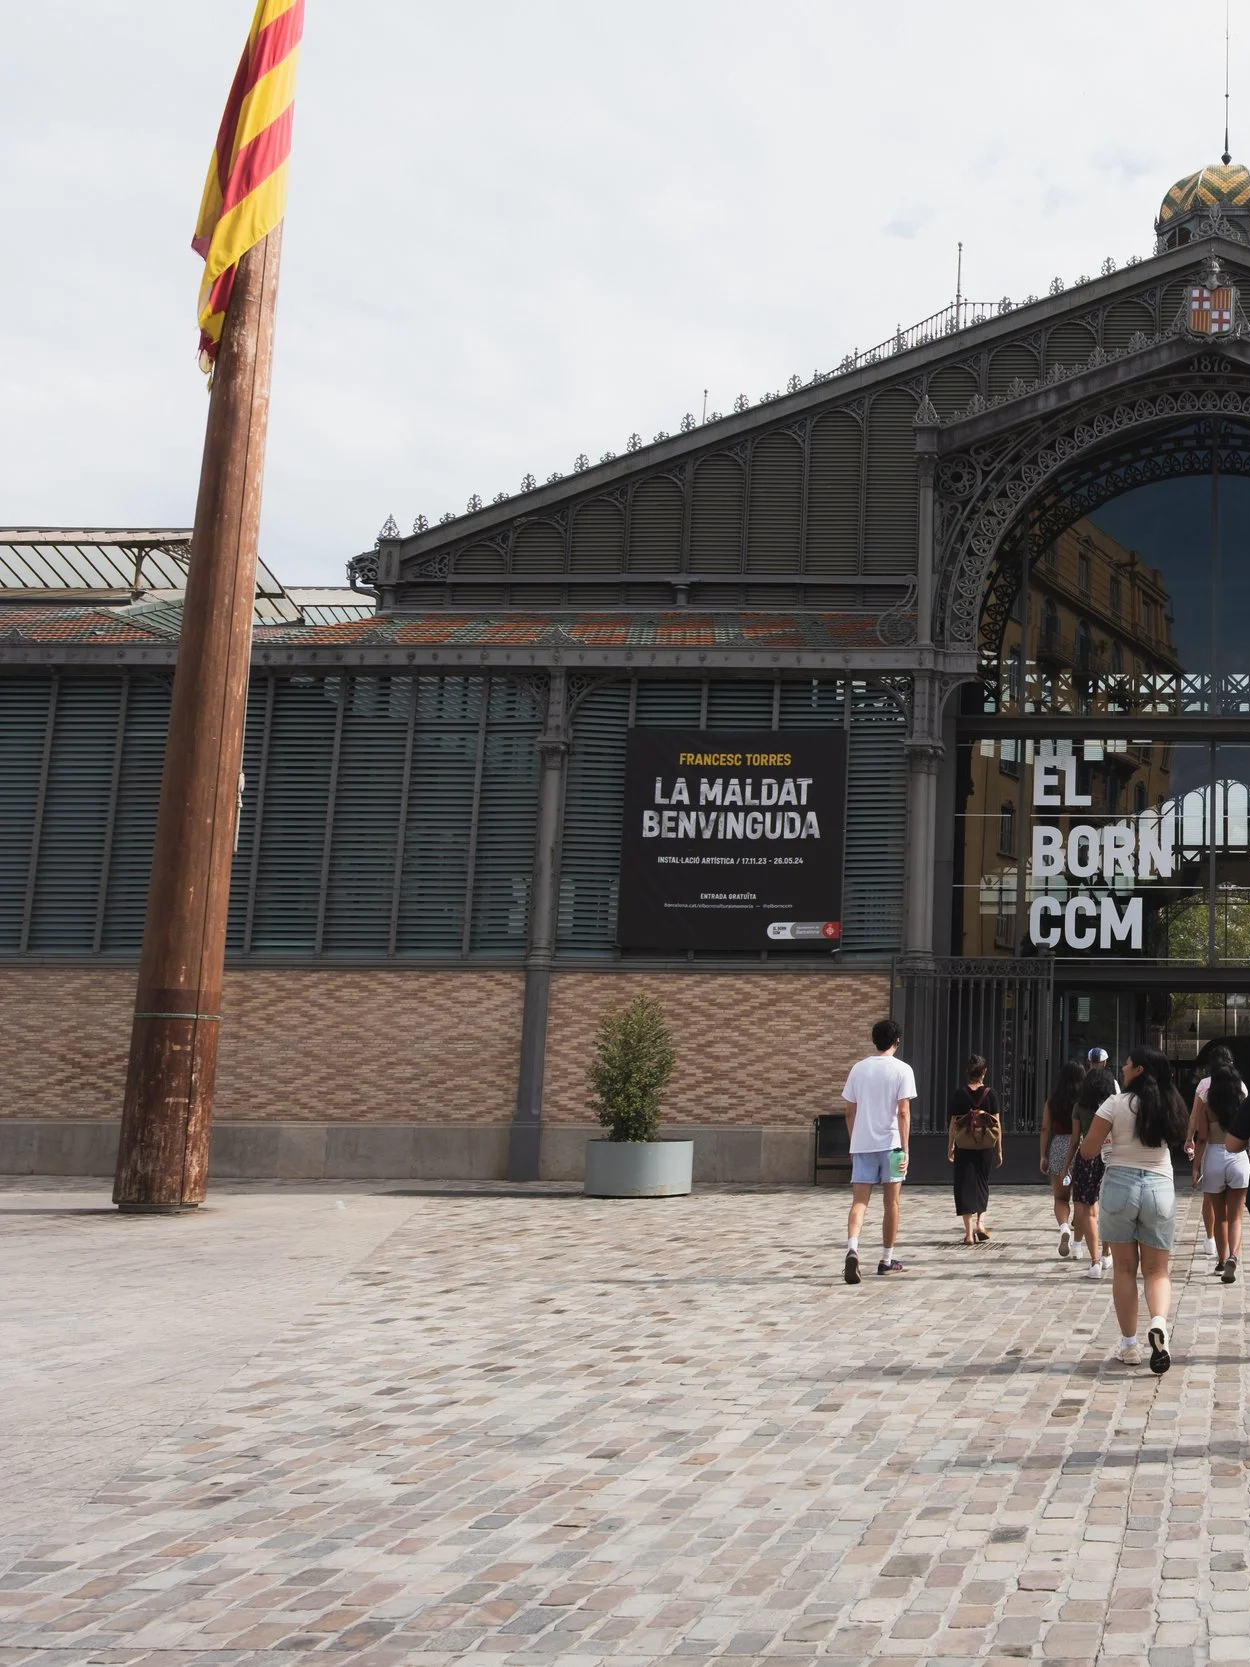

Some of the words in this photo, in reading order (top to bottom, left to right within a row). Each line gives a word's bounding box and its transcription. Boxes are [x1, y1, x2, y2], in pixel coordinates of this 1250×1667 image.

[1190, 356, 1231, 372] 1876
[679, 753, 742, 766] FRANCESC
[746, 754, 792, 766] TORRES
[654, 777, 691, 805] LA
[699, 778, 813, 806] MALDAT
[1033, 755, 1092, 806] EL
[642, 810, 821, 840] BENVINGUDA
[701, 856, 735, 864] ARTÍSTICA
[773, 857, 803, 865] 26.05.24
[1032, 825, 1173, 878] BORN
[728, 892, 757, 900] GRATUÏTA
[1029, 896, 1143, 949] CCM
